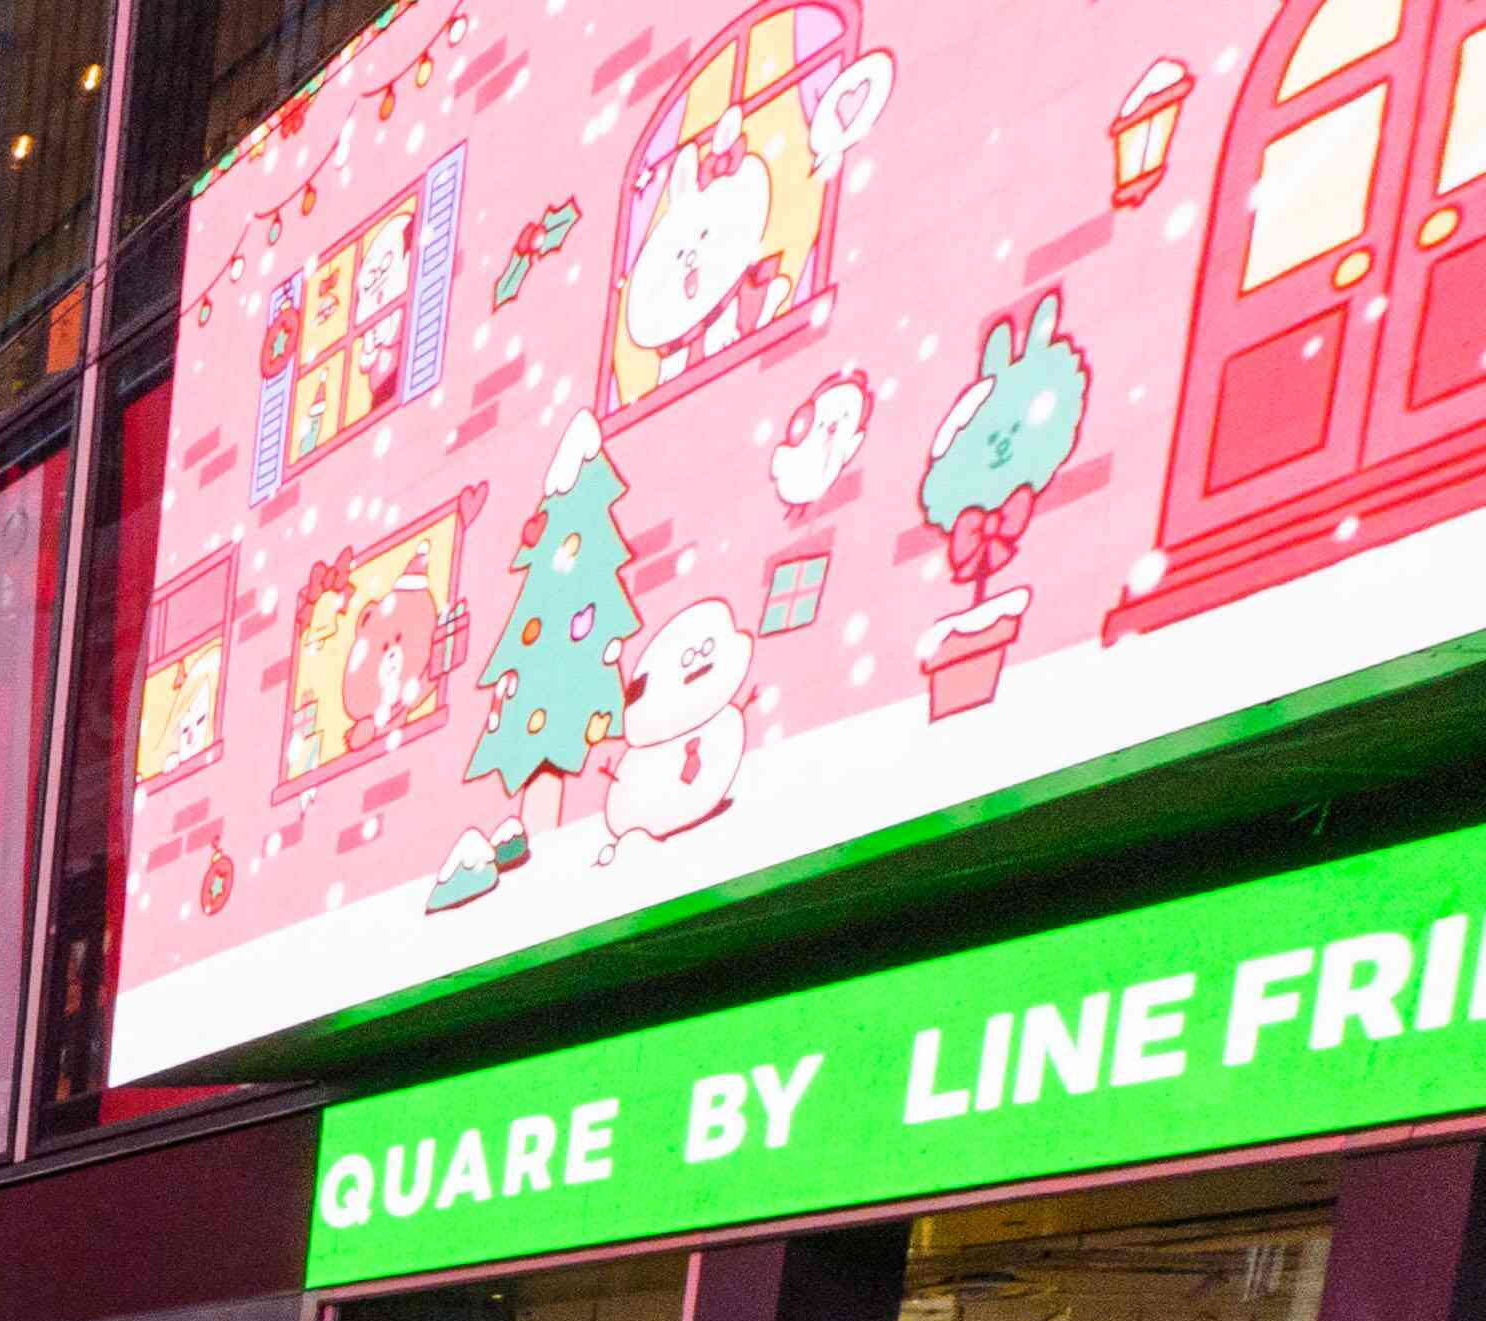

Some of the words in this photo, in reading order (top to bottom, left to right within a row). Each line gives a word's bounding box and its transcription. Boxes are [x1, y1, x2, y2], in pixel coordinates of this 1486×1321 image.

[320, 1099, 619, 1228] QUARE
[684, 1055, 823, 1164] BY
[903, 973, 1196, 1126] LINE
